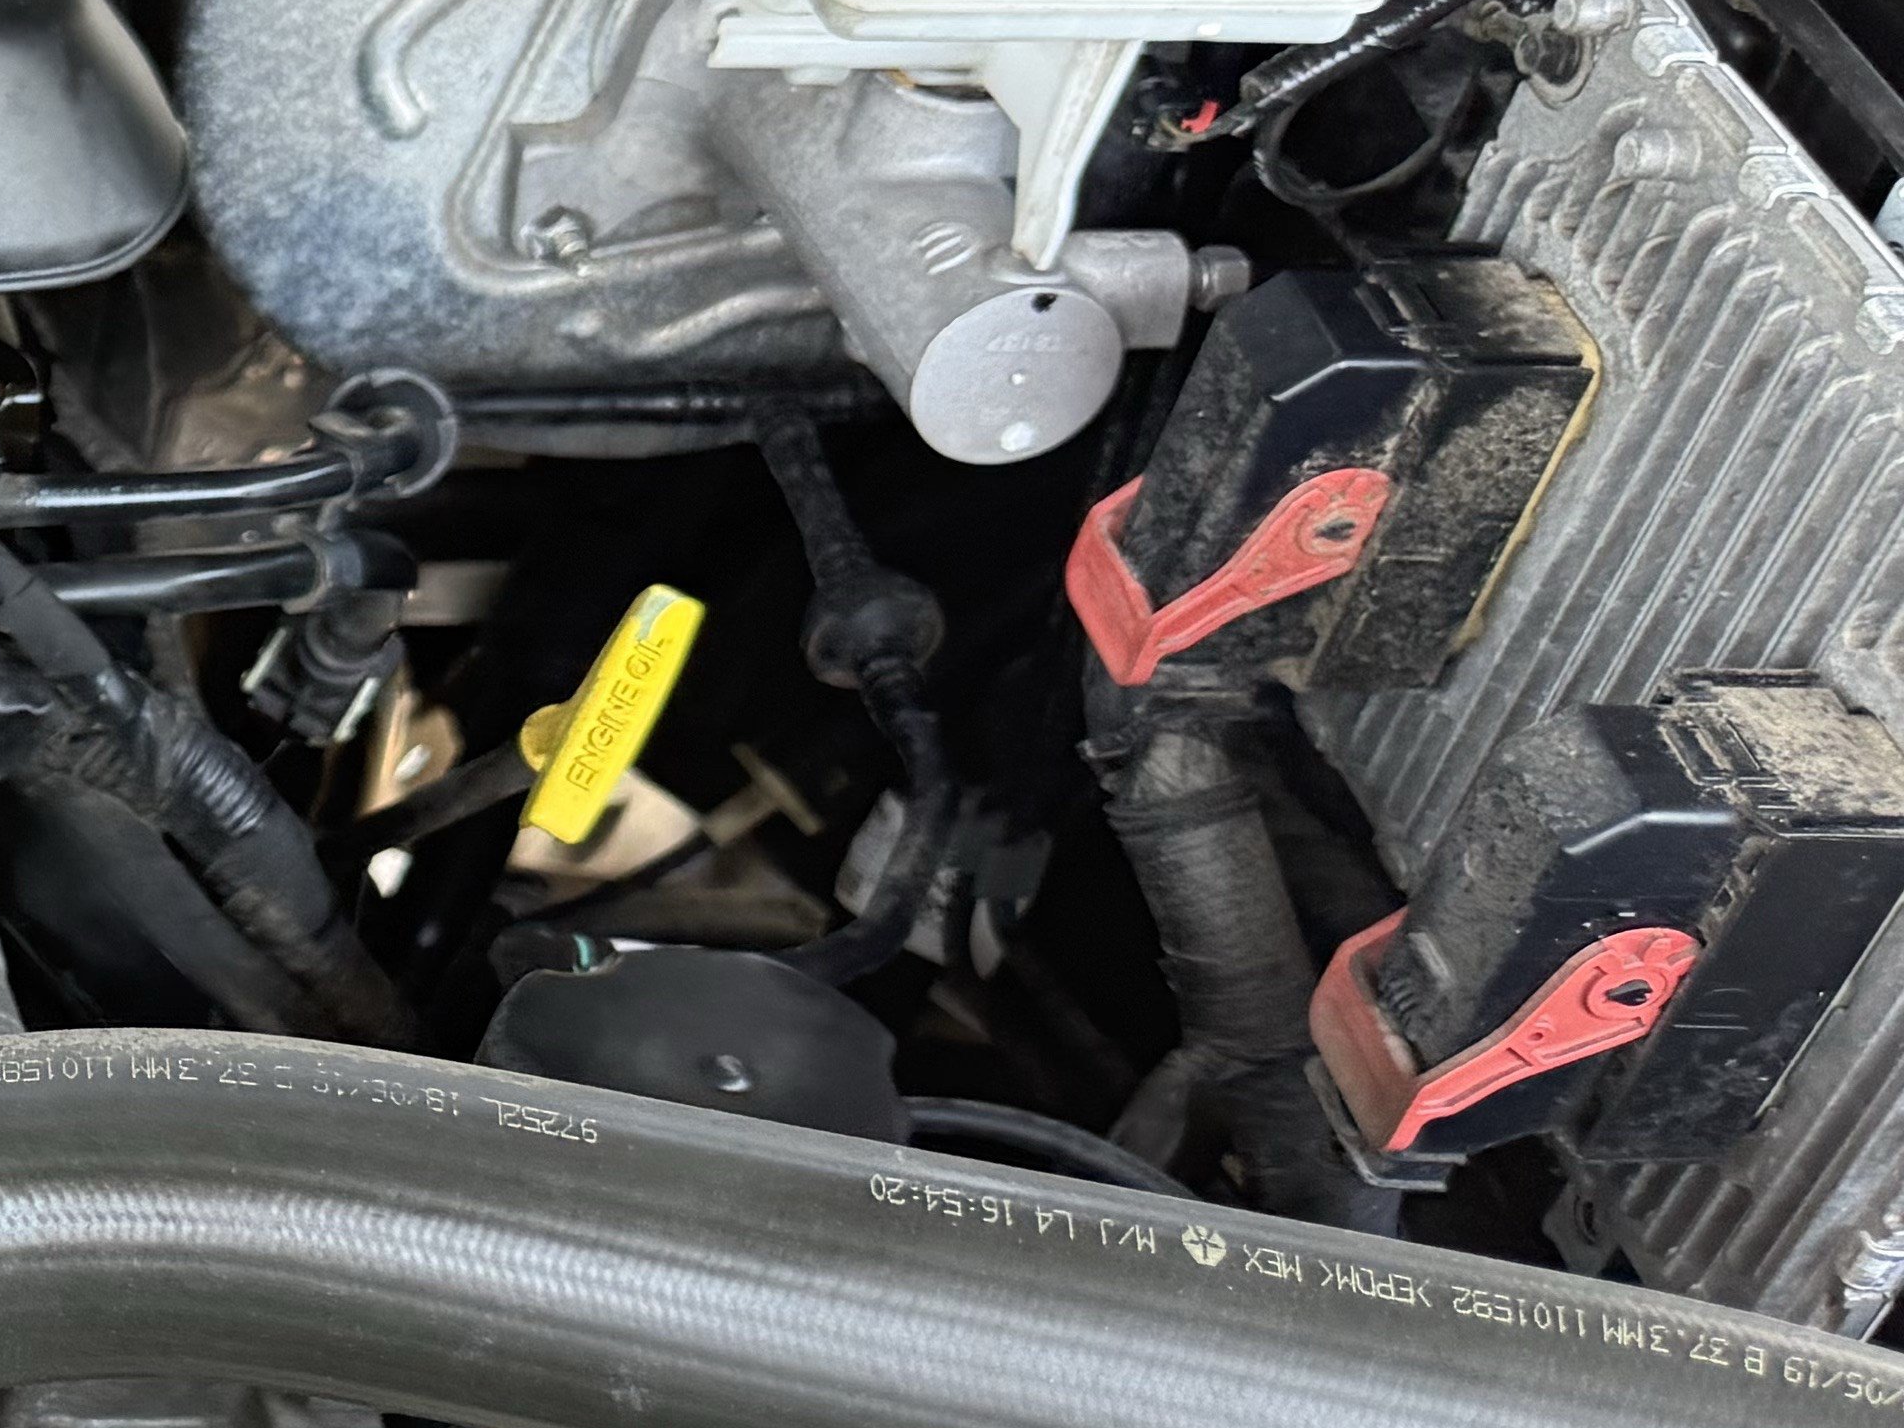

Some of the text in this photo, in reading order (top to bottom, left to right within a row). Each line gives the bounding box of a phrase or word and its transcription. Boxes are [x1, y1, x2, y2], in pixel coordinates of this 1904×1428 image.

[566, 638, 667, 792] ENGINE OIL
[869, 1173, 1014, 1226] 16:54:20
[1035, 1205, 1076, 1241] L4
[1243, 1244, 1303, 1282] MEX
[1602, 1313, 1730, 1367] 37.3MM
[1743, 1345, 1766, 1377] B
[1783, 1356, 1904, 1410] /06/19
